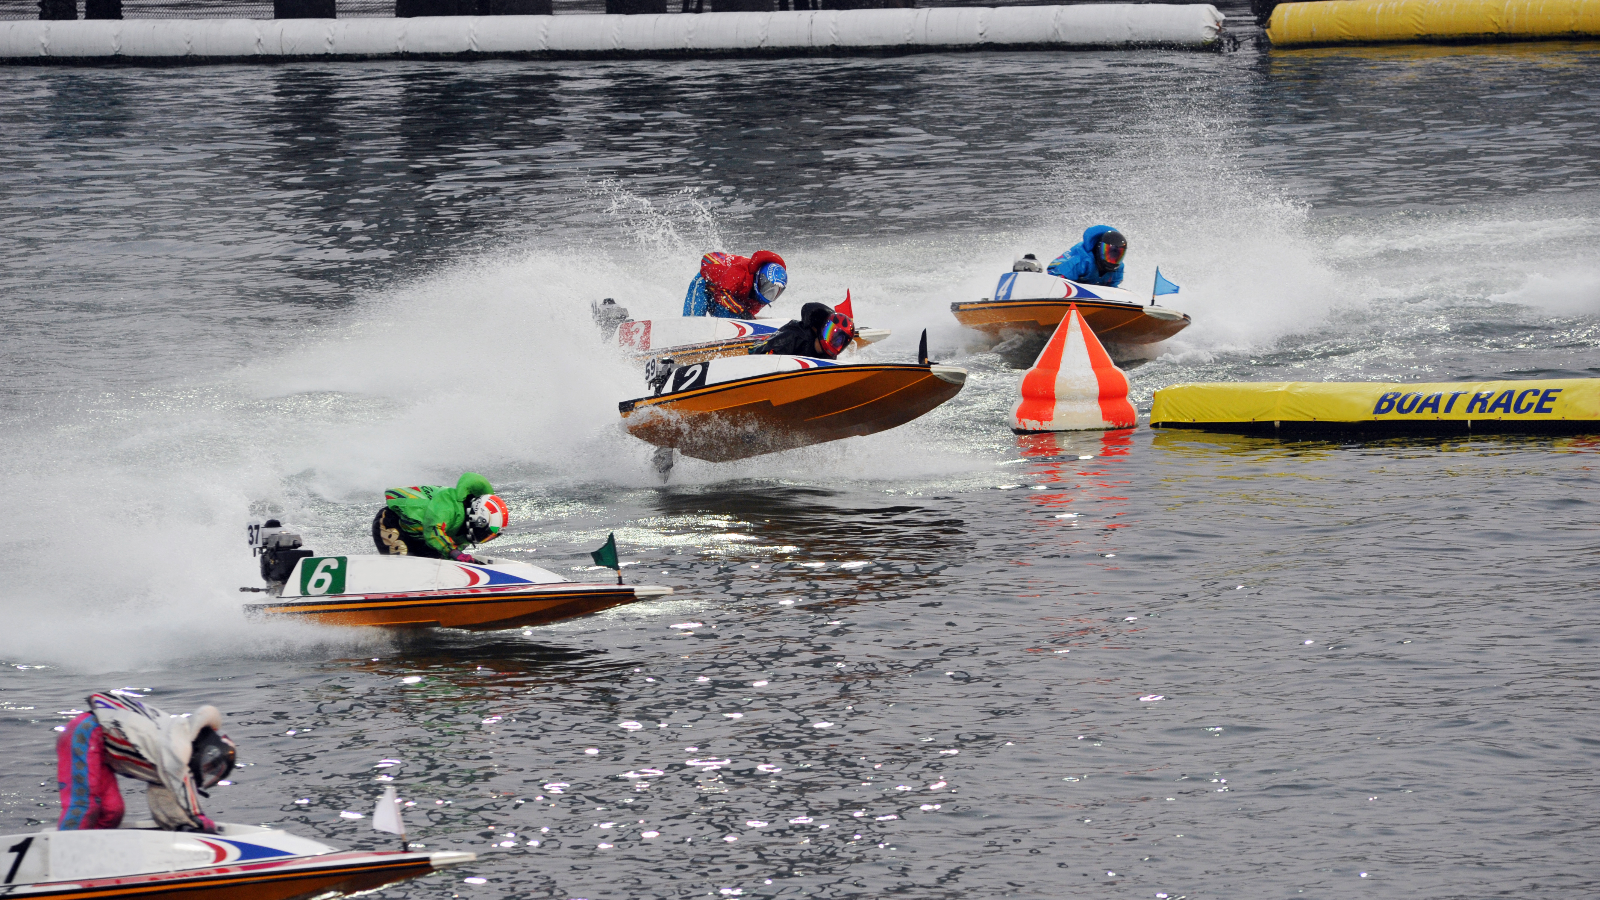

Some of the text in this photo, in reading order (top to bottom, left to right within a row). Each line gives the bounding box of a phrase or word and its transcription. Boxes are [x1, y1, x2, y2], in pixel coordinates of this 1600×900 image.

[997, 273, 1014, 300] 4
[645, 358, 656, 380] 59
[677, 364, 703, 391] 2
[1373, 388, 1563, 414] BOAT RACE
[247, 524, 260, 545] 37
[307, 558, 339, 595] 6
[4, 837, 35, 884] 1
